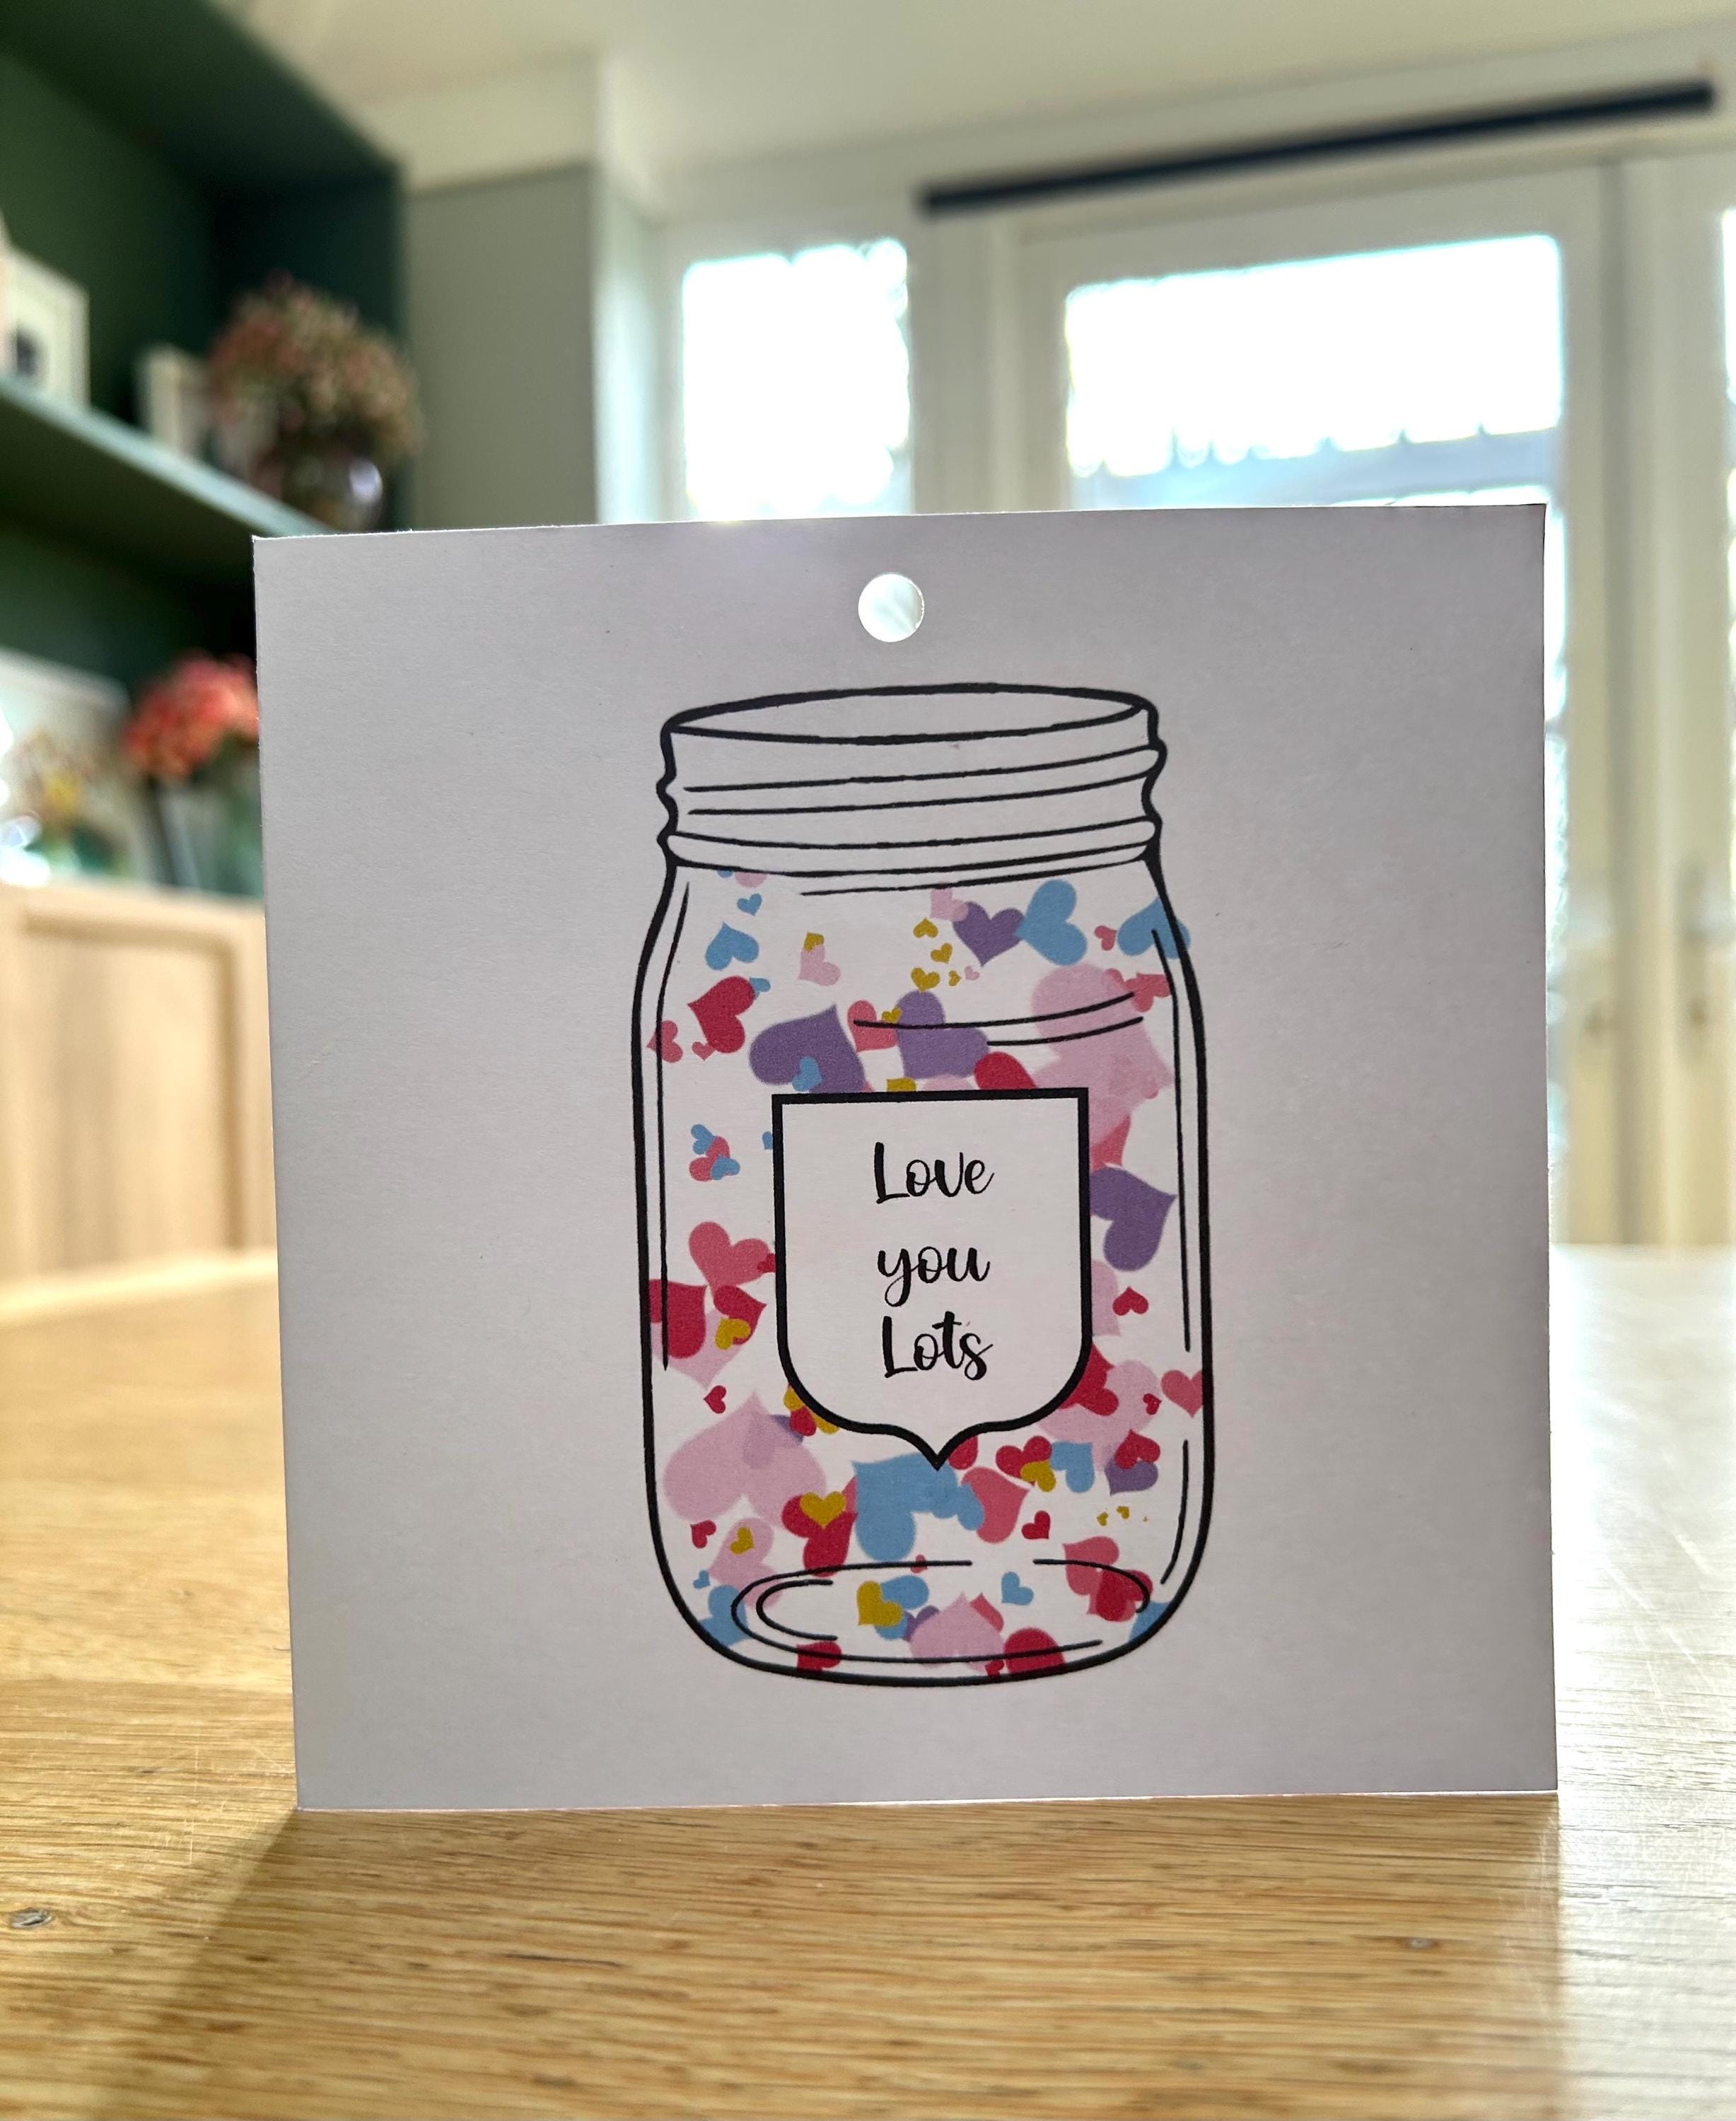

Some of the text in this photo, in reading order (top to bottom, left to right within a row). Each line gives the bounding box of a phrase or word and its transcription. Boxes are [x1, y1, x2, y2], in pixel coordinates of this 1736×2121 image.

[873, 1141, 995, 1205] Love
[877, 1246, 991, 1308] you
[882, 1310, 994, 1381] Lots
